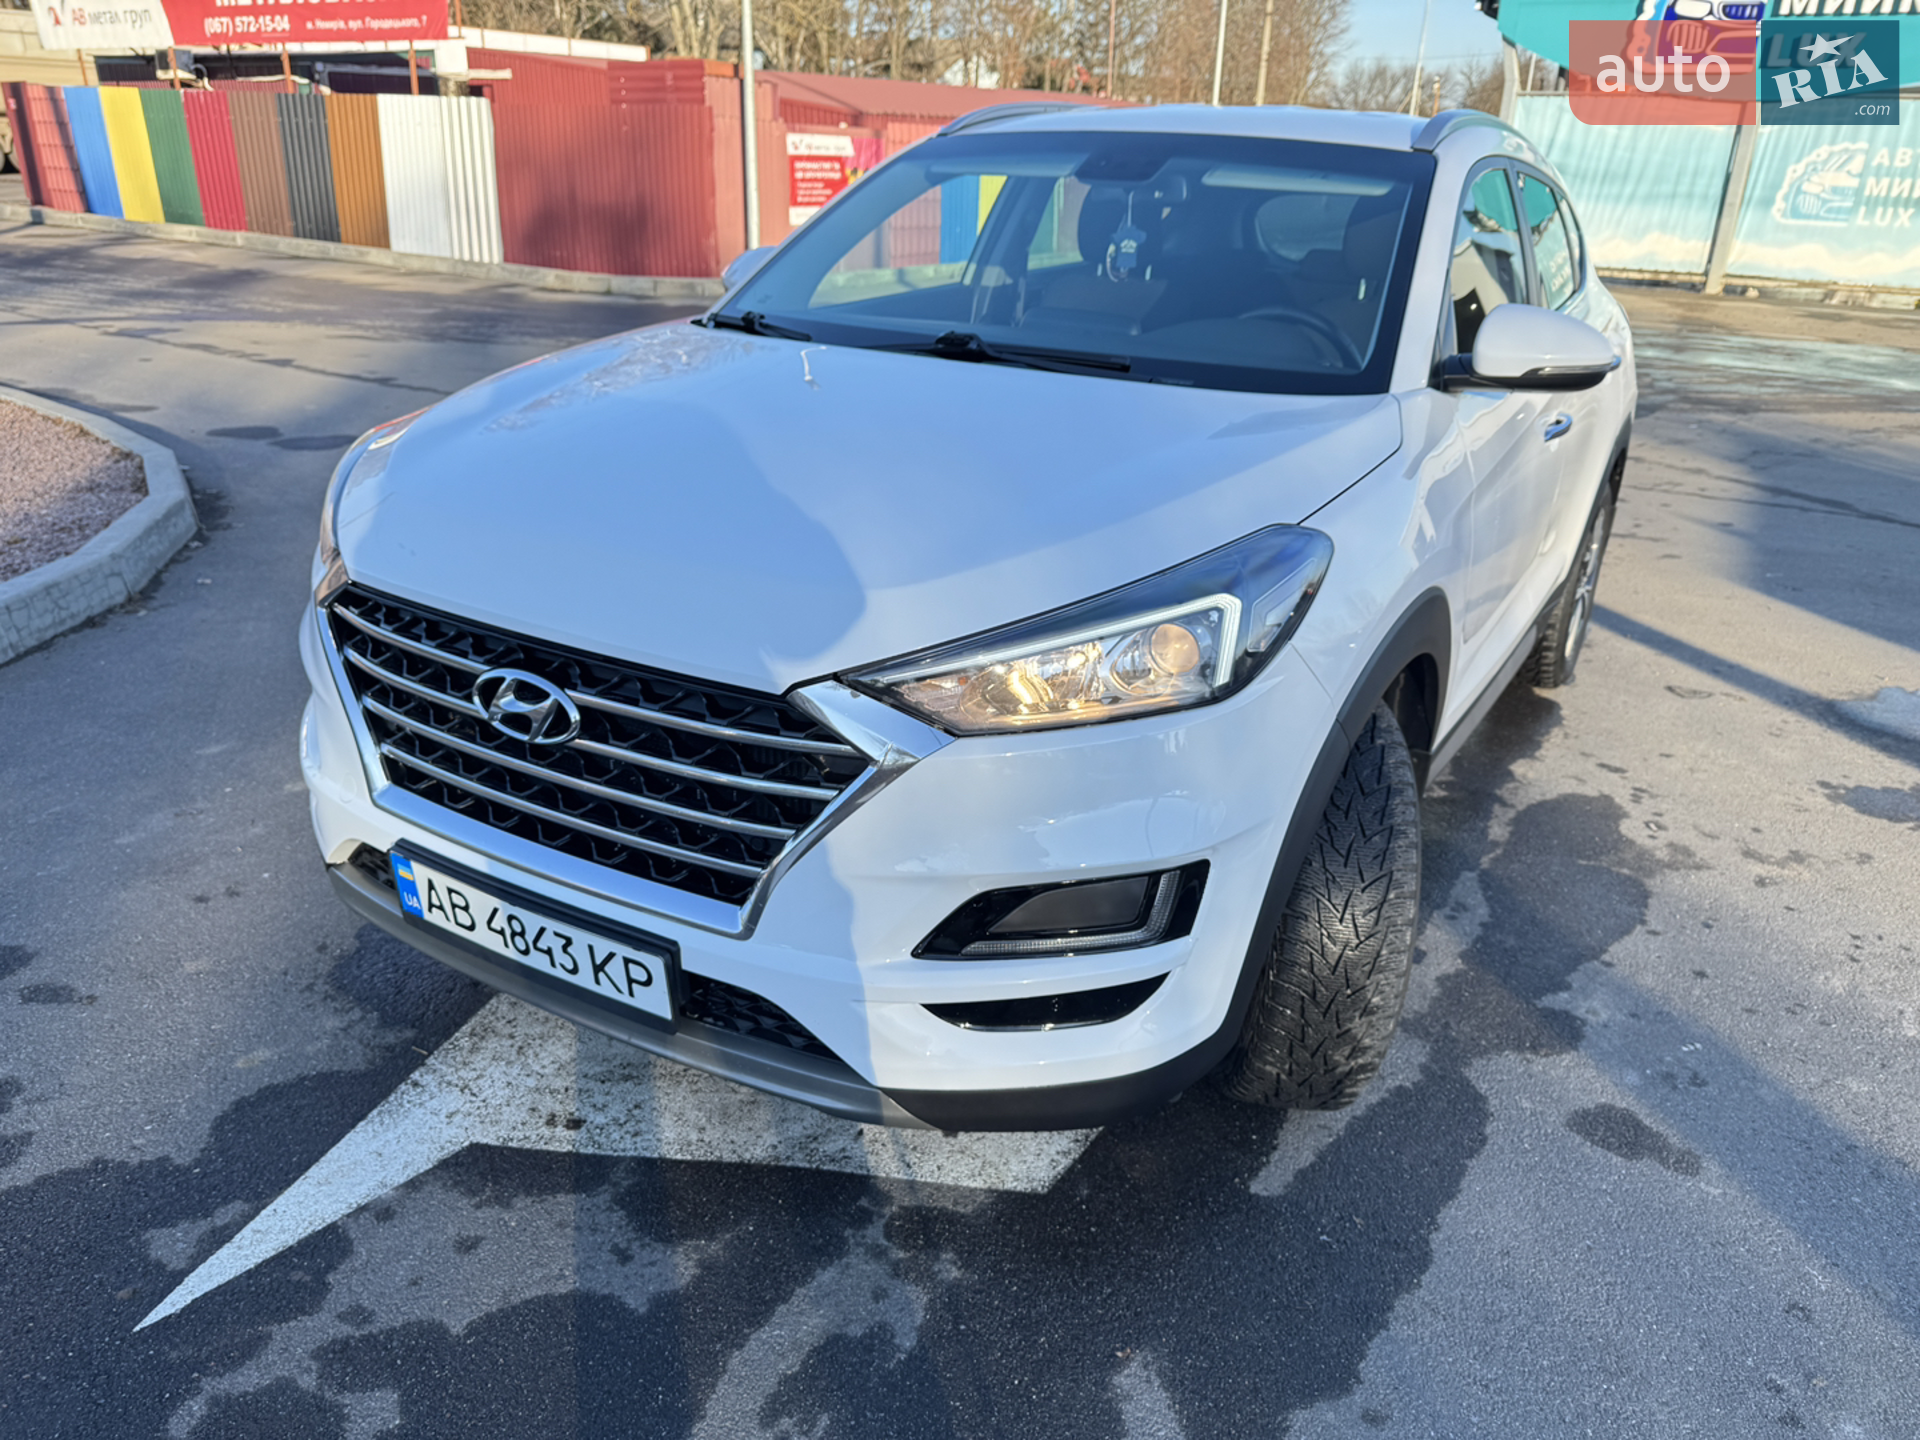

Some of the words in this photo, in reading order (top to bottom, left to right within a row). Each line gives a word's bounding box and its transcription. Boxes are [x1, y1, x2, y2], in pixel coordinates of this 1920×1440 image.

[124, 9, 152, 28] груп
[204, 16, 233, 37] (067)
[235, 15, 291, 33] 572-15-04
[1856, 205, 1915, 227] LUX
[404, 891, 421, 910] UA
[427, 877, 476, 932] AB
[486, 907, 579, 976] 4843
[588, 944, 653, 998] KP
